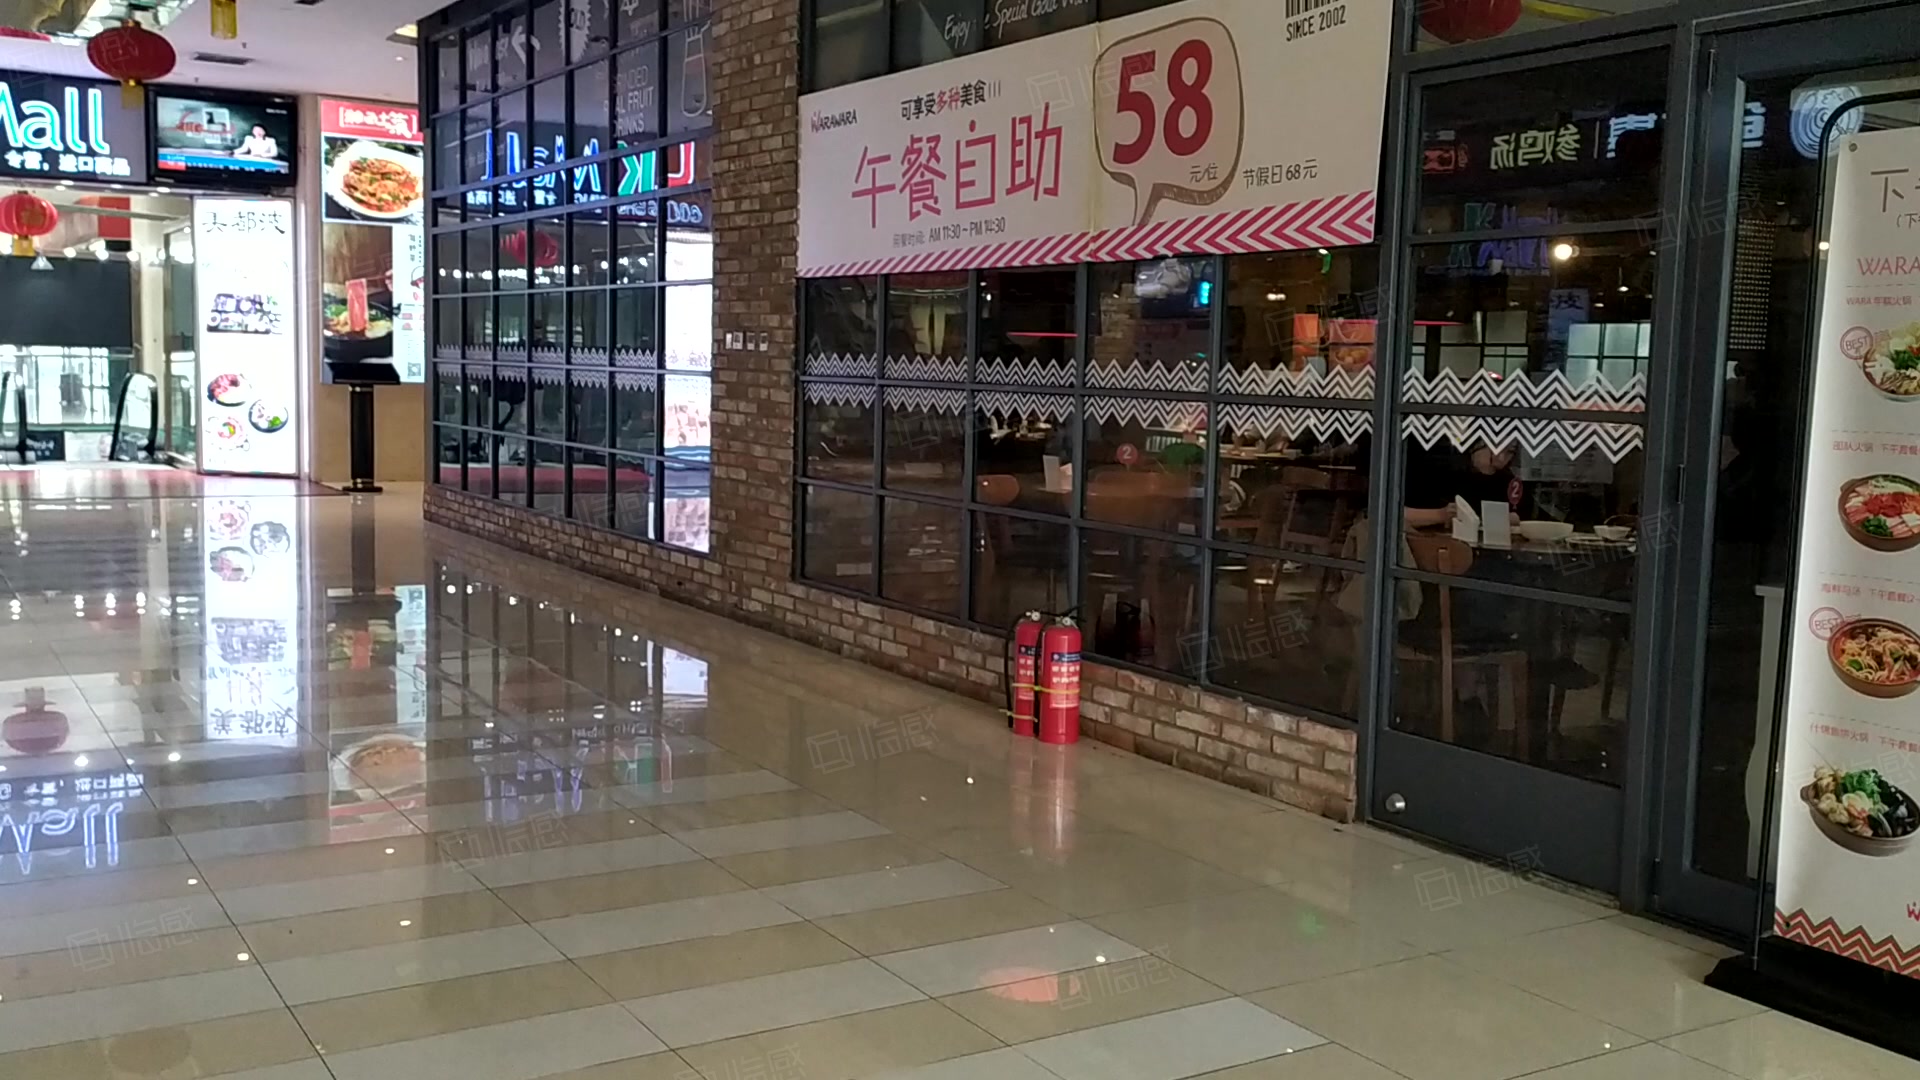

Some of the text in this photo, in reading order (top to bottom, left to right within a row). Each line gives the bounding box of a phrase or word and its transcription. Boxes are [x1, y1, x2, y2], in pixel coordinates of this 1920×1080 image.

[1286, 5, 1346, 42] SINCE 2002
[901, 79, 987, 120] 可享受多种美食
[1112, 39, 1213, 164] 58
[852, 102, 1063, 229] 午餐自助
[1243, 159, 1318, 189] 节假日68元
[1122, 445, 1133, 460] 2
[1511, 481, 1520, 498] 2
